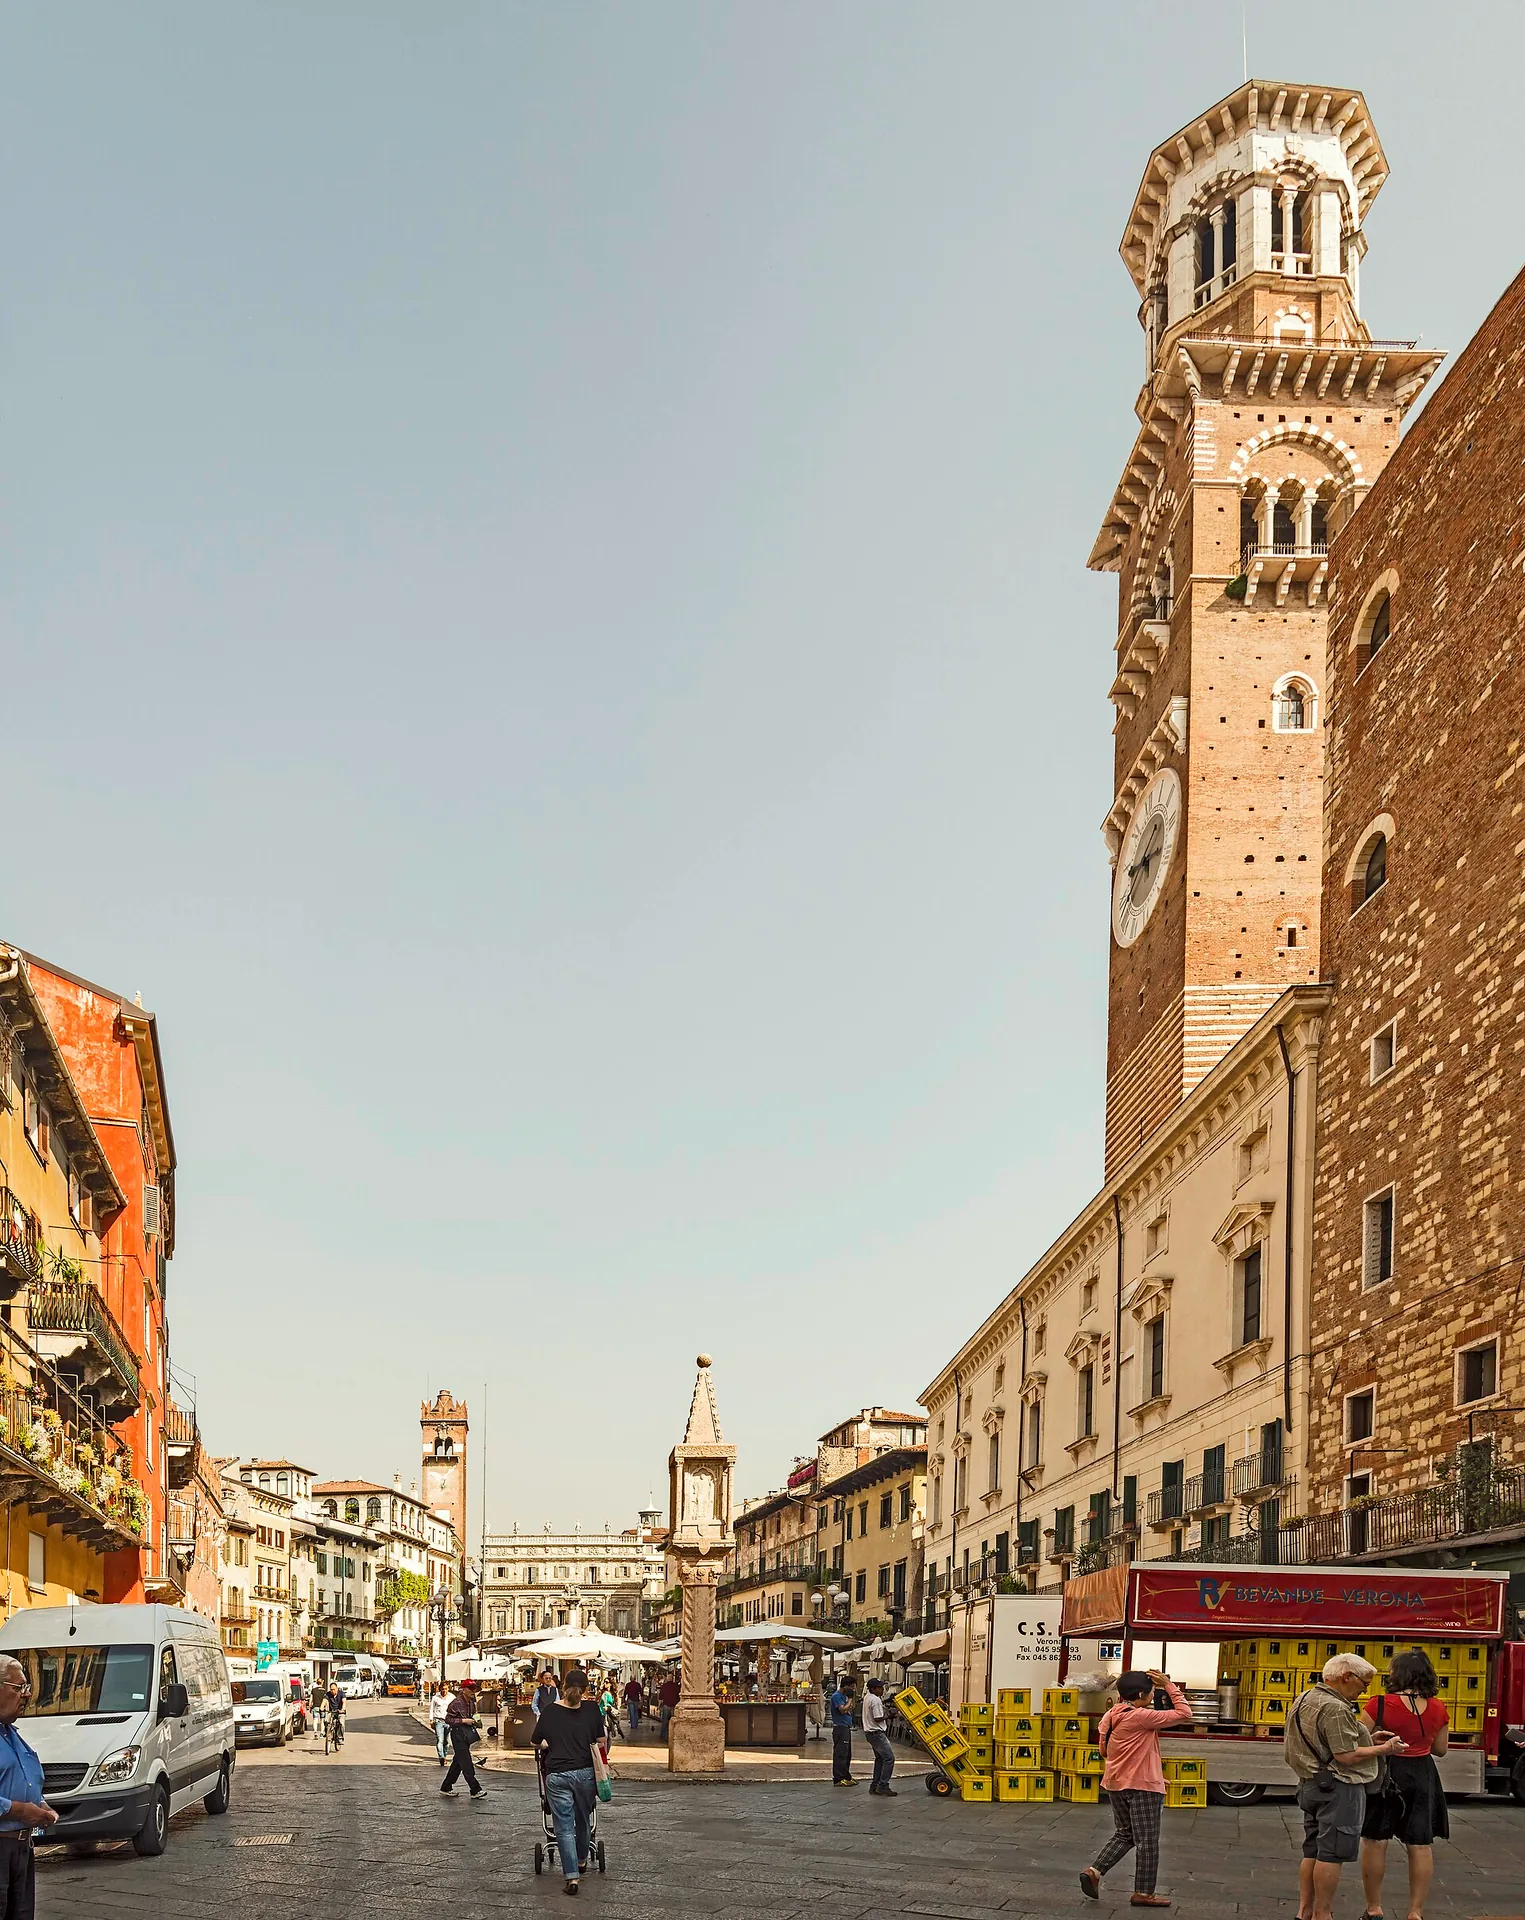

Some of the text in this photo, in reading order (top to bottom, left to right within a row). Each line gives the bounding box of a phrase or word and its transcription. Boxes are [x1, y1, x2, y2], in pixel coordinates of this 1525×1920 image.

[1235, 1587, 1426, 1607] BEVANDE VERONA
[1017, 1621, 1052, 1636] C.S.
[1019, 1645, 1032, 1653] Tel.
